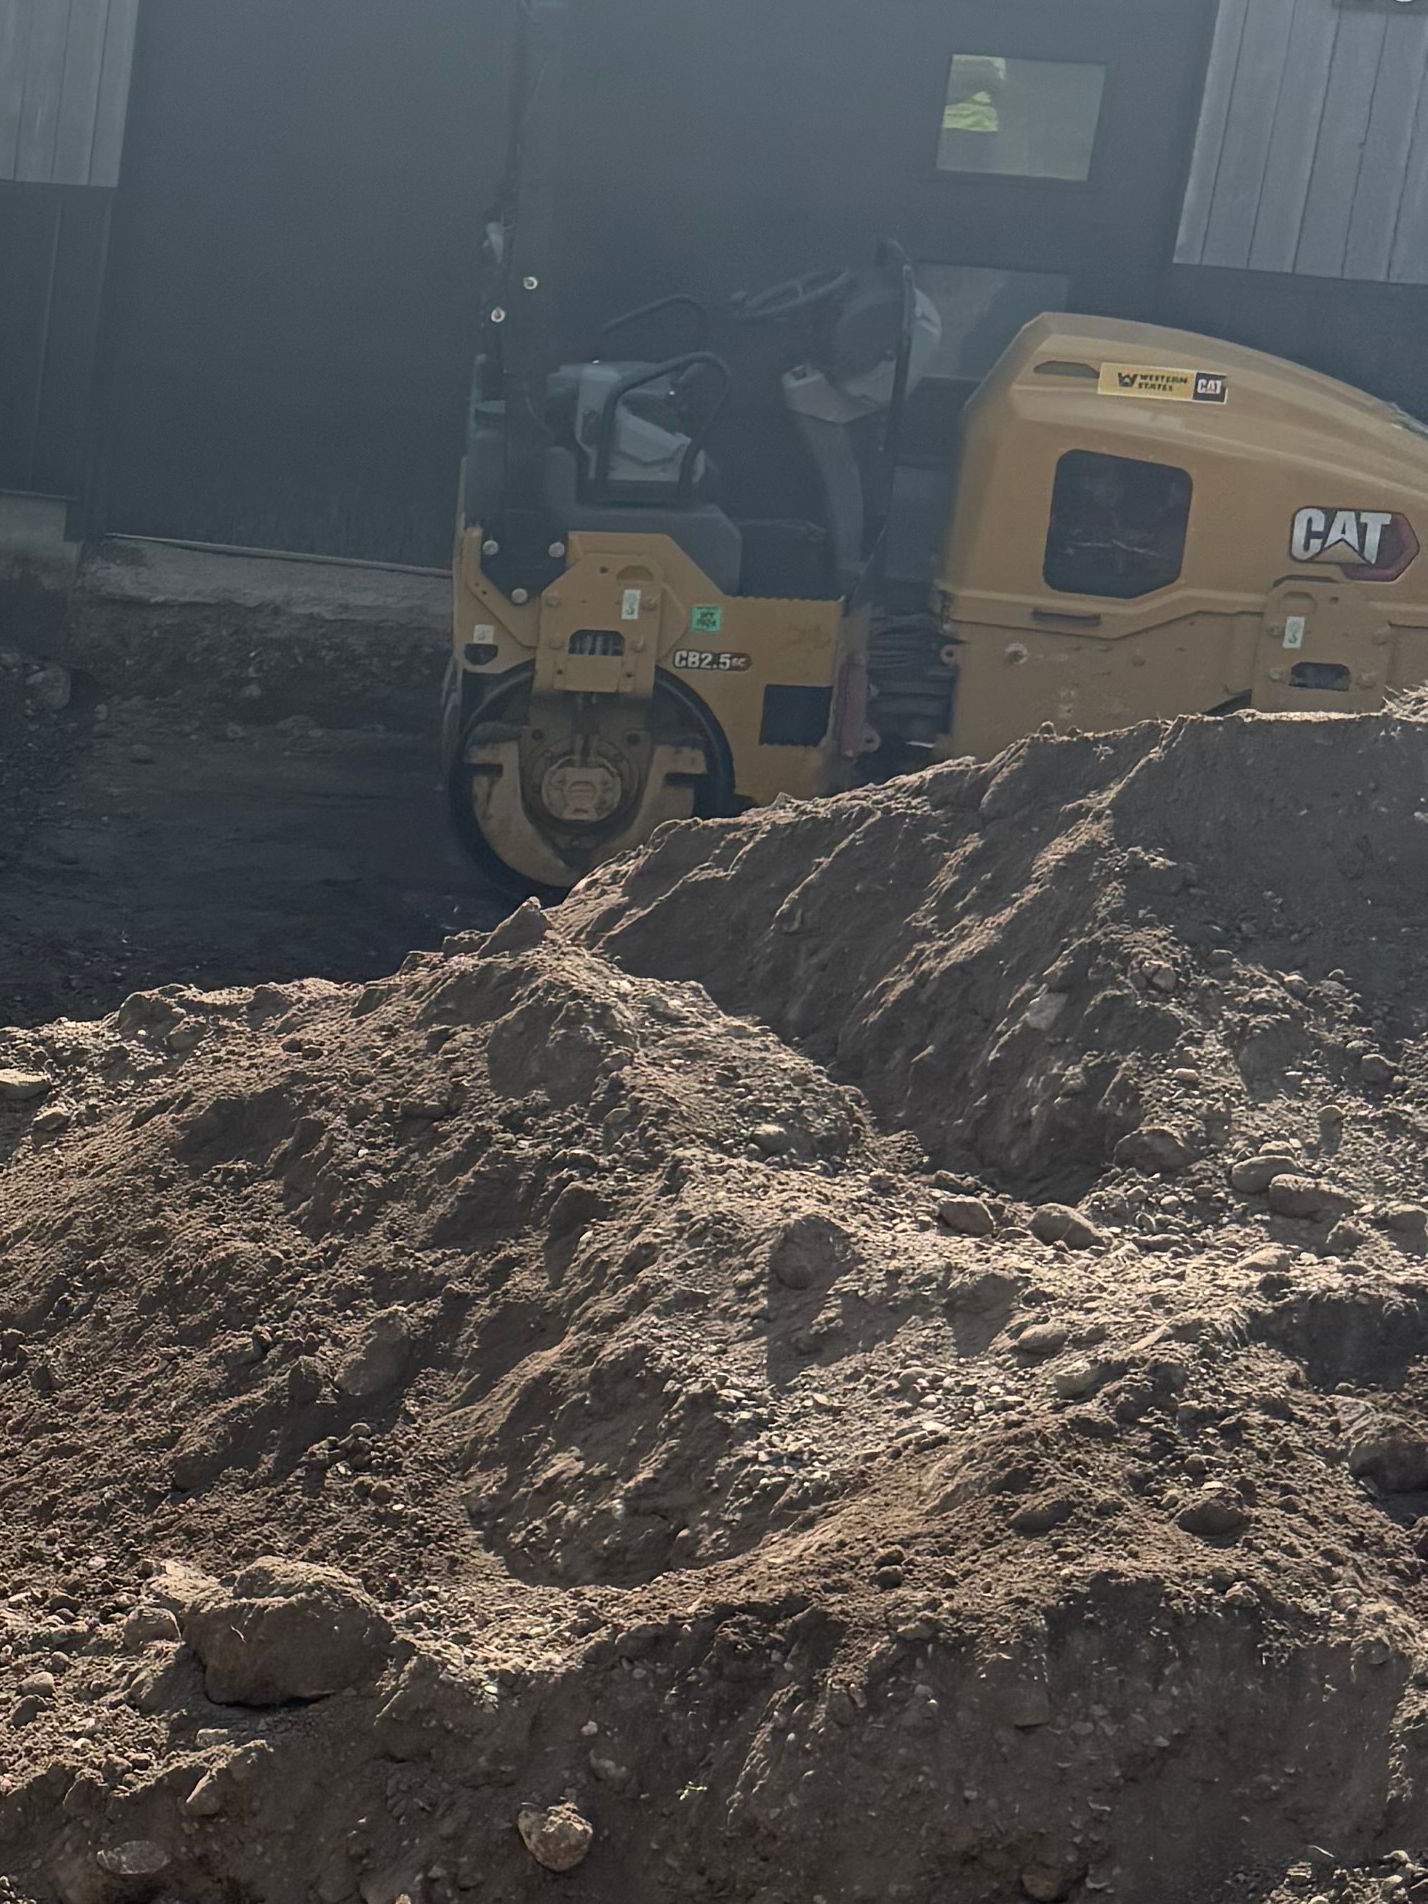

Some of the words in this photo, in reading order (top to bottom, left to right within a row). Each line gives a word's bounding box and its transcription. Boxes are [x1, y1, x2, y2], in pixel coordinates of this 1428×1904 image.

[1197, 379, 1222, 394] CAT
[1291, 508, 1392, 565] CAT
[674, 650, 731, 669] CB2.5
